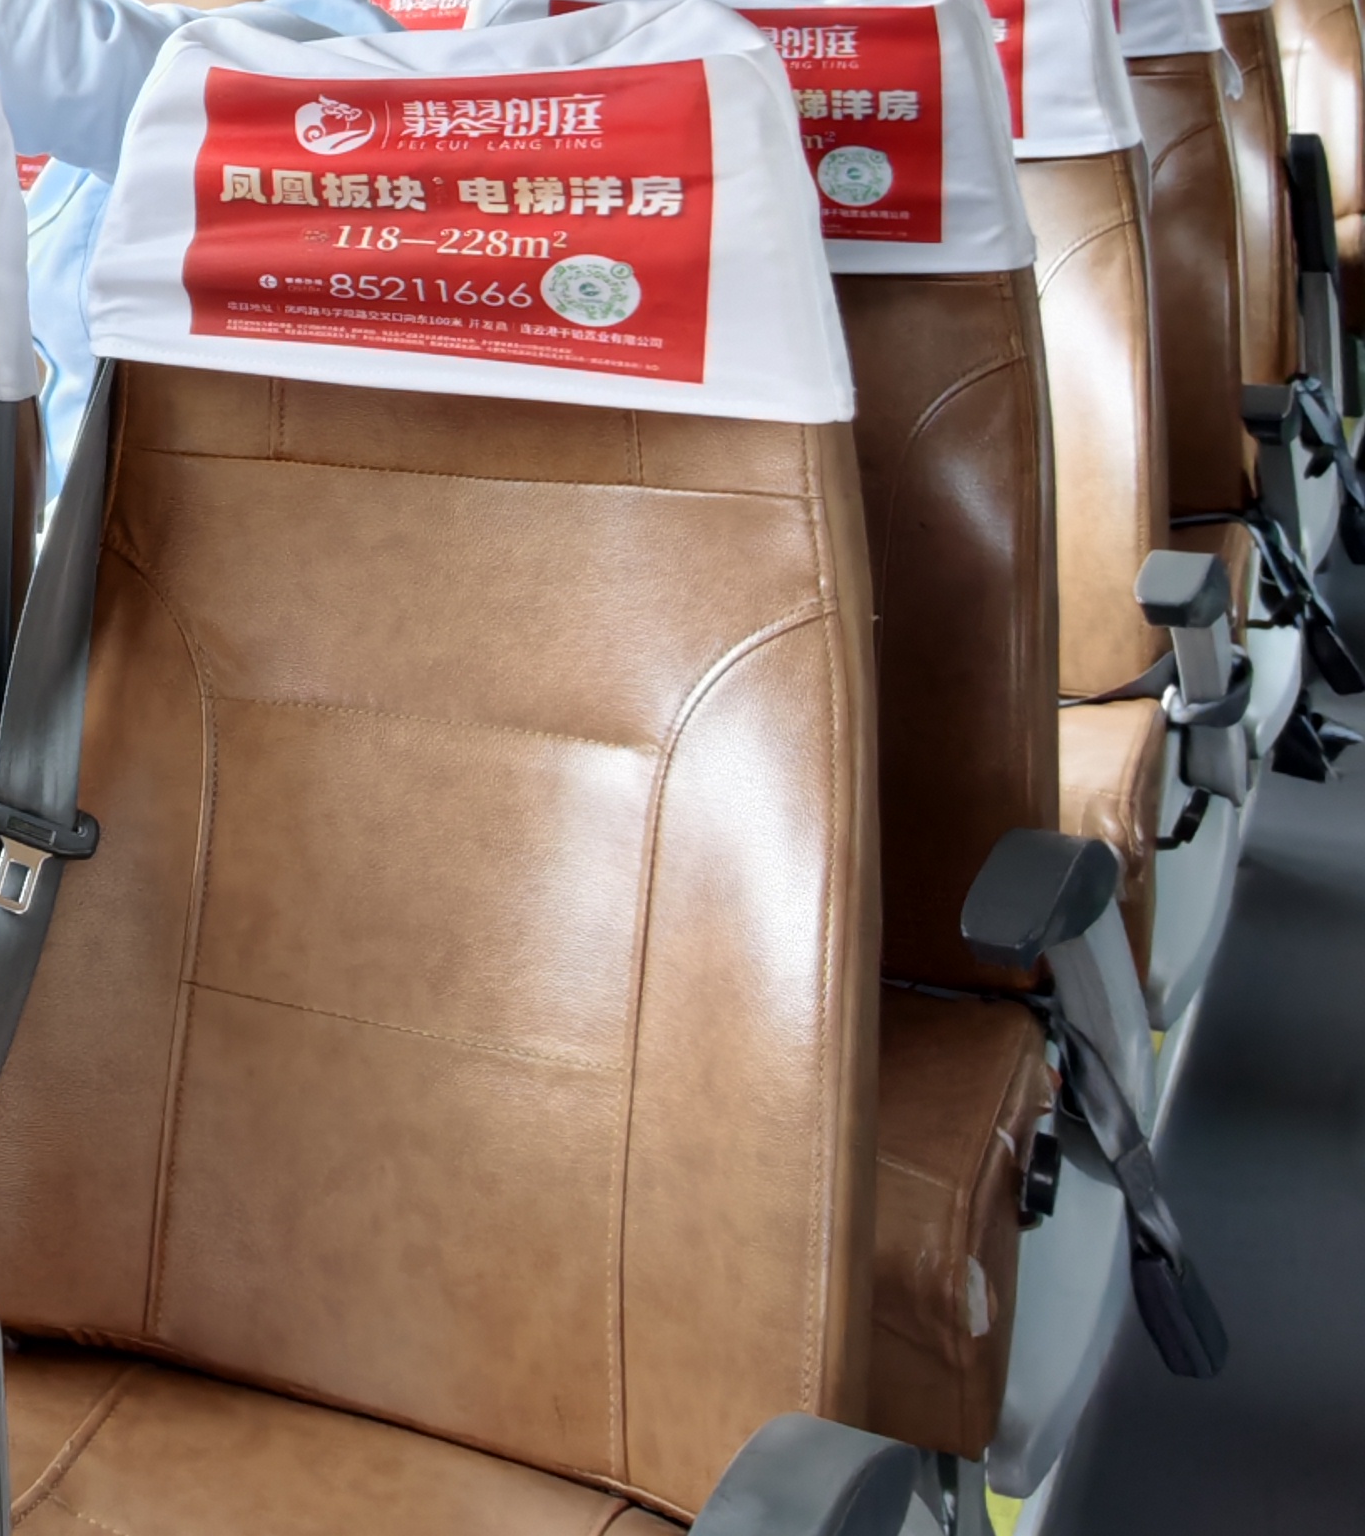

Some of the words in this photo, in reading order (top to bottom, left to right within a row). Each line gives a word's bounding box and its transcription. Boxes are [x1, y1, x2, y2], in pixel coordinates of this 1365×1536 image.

[400, 94, 607, 138] 翡翠朗庭
[436, 140, 469, 151] CUI
[487, 139, 542, 152] LANG
[554, 138, 603, 150] TING
[220, 164, 426, 212] 凤凰板块
[457, 175, 685, 218] 电梯洋房
[329, 273, 533, 308] 85211666
